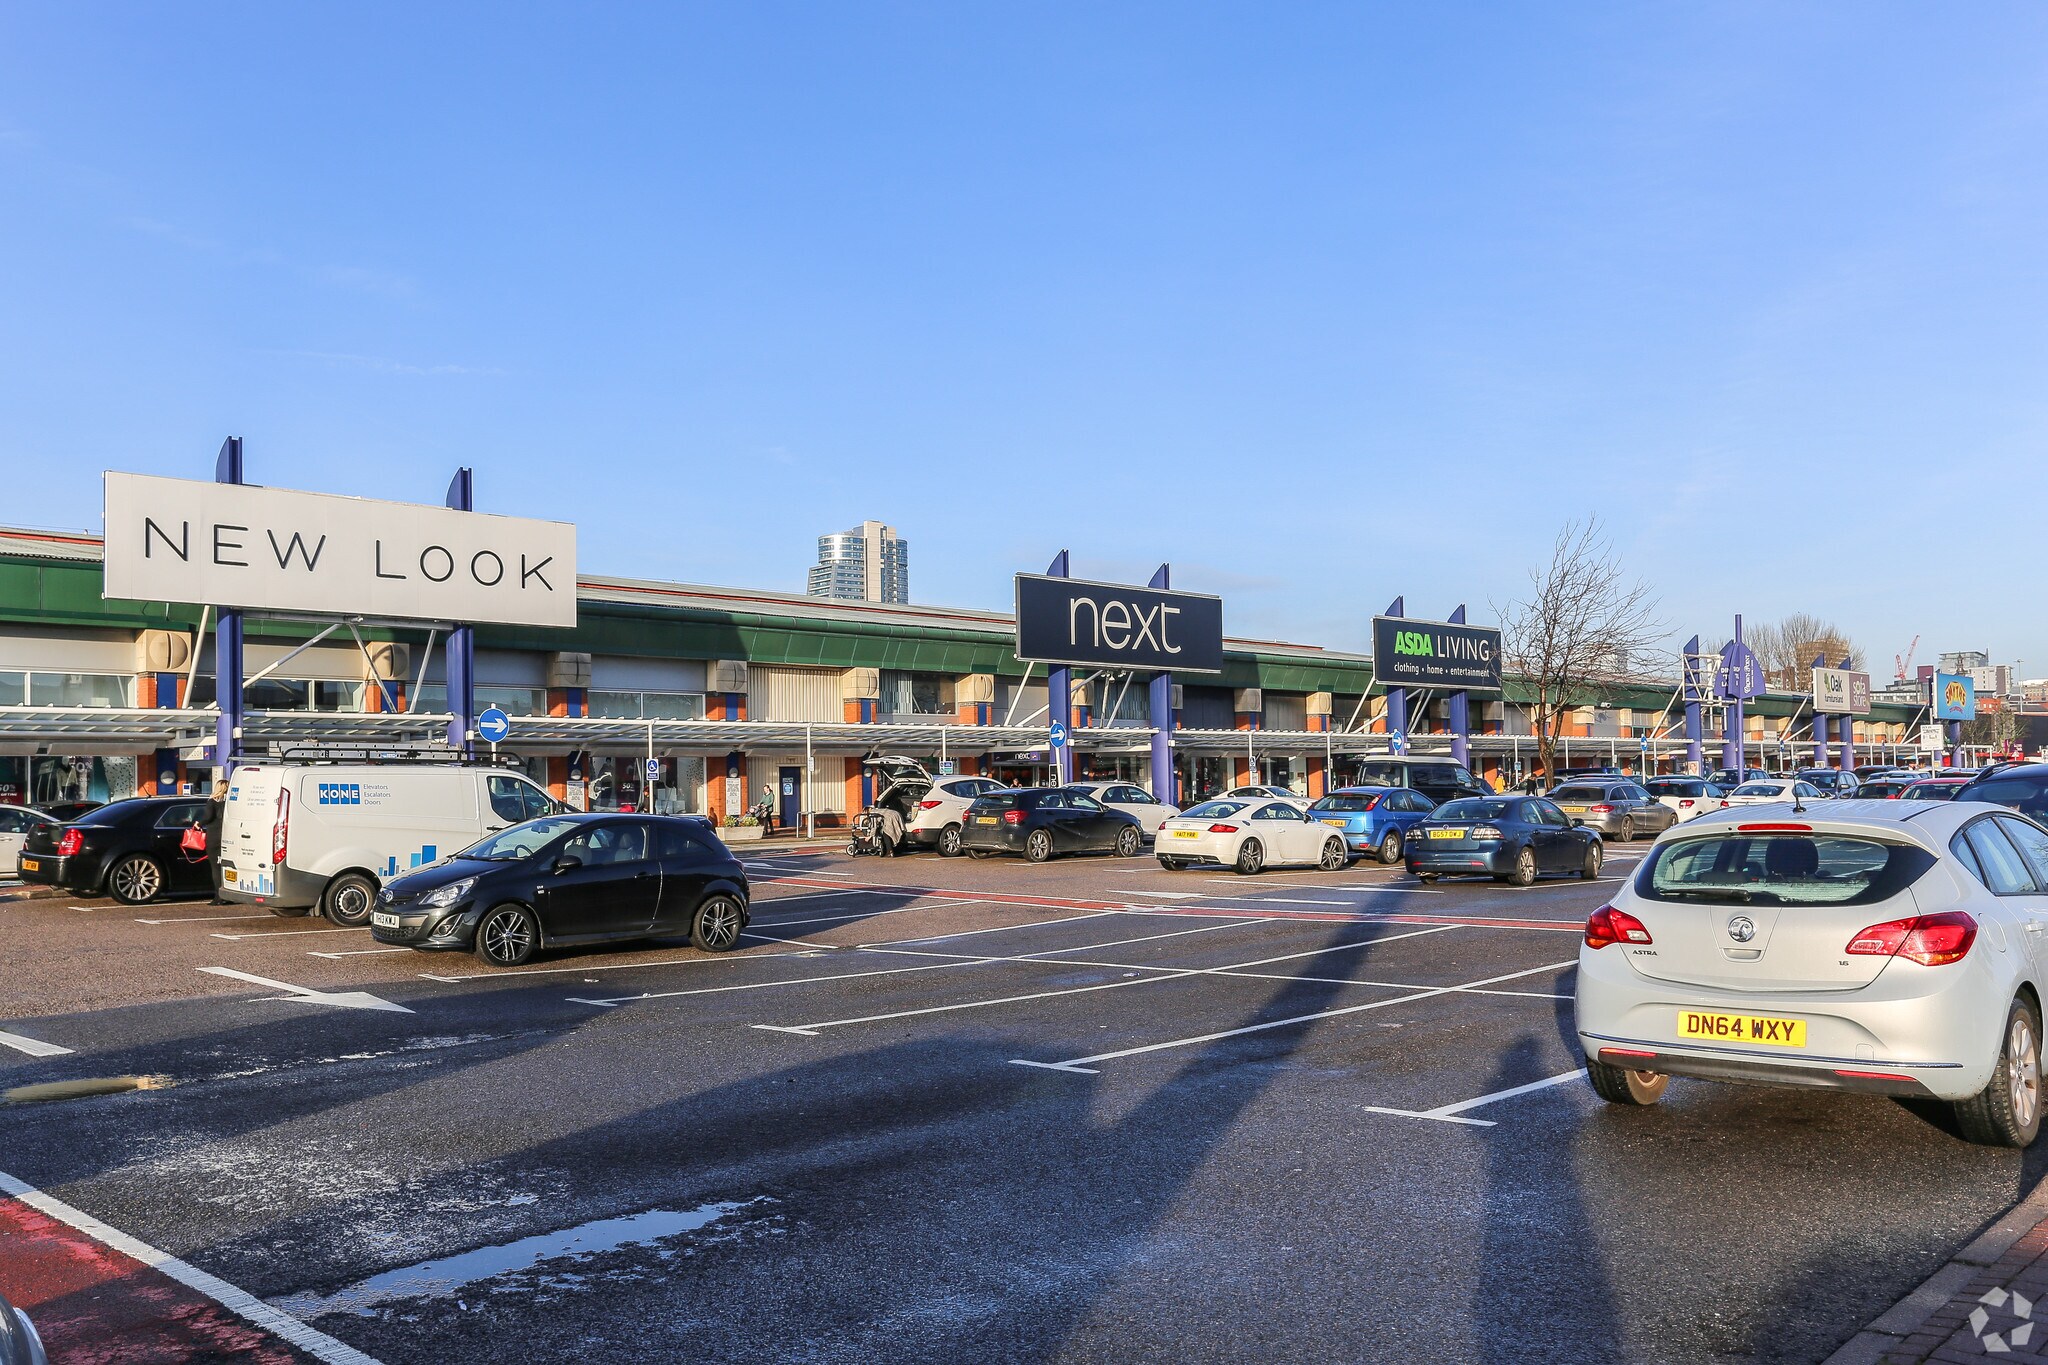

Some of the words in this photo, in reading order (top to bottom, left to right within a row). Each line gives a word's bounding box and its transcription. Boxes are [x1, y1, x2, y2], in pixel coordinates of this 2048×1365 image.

[145, 517, 327, 572] NEW
[375, 539, 555, 592] LOOK
[1070, 597, 1182, 654] next
[1394, 631, 1434, 657] ASDA
[1437, 635, 1490, 662] LIVING
[1394, 662, 1420, 675] clothing
[1426, 664, 1444, 675] home
[1450, 667, 1490, 678] entertainment
[1830, 674, 1843, 692] Oak
[1852, 676, 1866, 695] sofa
[1853, 694, 1866, 707] store
[1014, 752, 1030, 760] next
[320, 790, 359, 798] KONE
[1687, 1014, 1743, 1037] DN64
[1751, 1019, 1795, 1041] WXY
